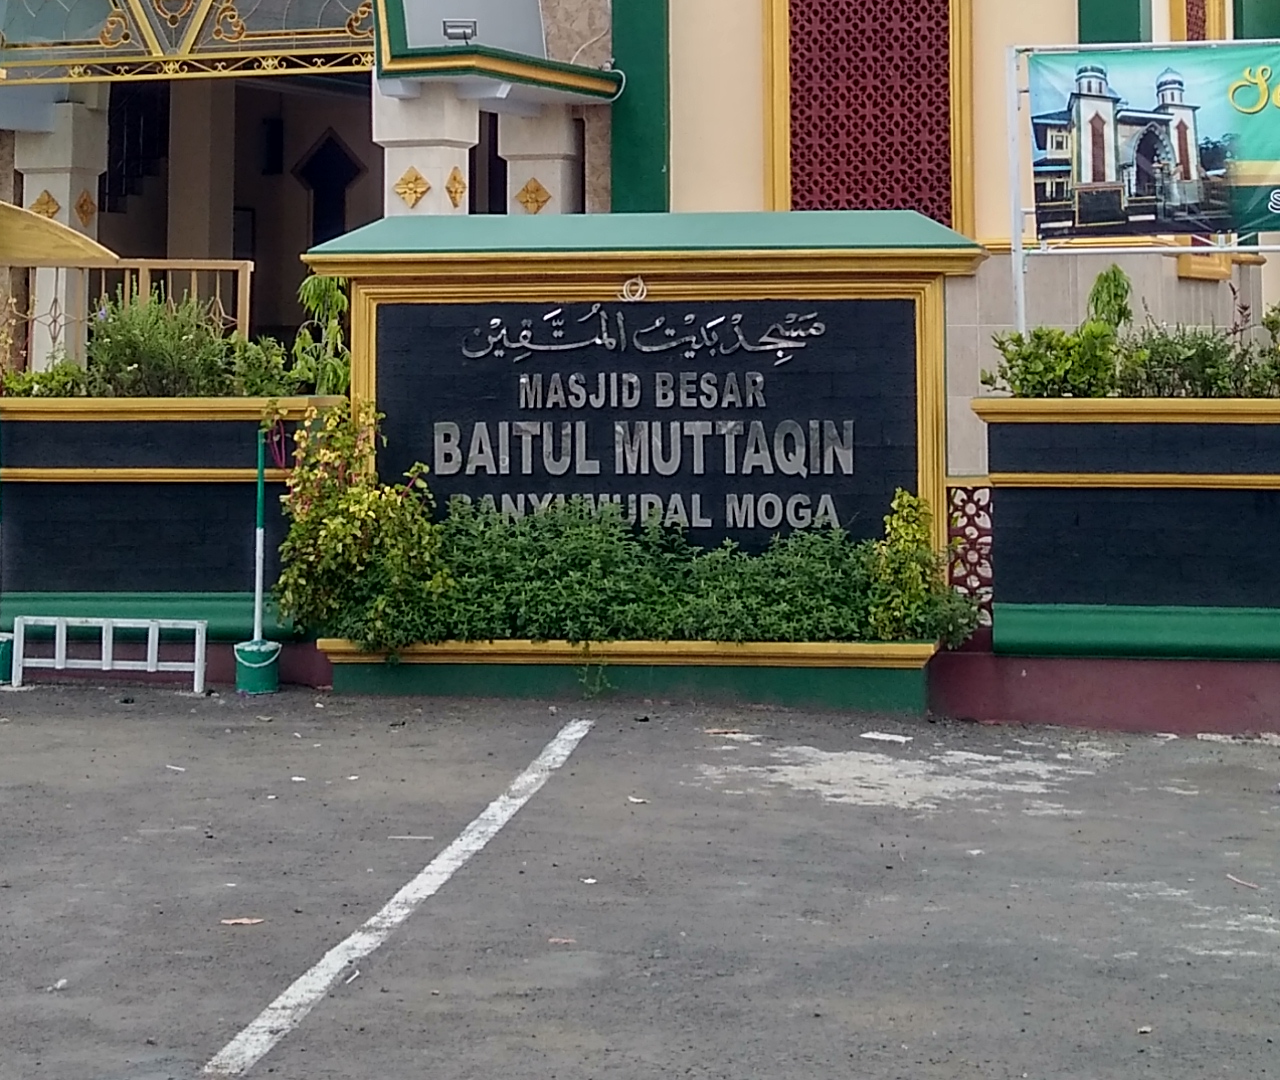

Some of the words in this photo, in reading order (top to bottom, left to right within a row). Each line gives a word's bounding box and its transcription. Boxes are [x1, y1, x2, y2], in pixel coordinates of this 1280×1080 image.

[520, 373, 641, 408] MASJID
[655, 372, 766, 408] BESAR
[433, 420, 600, 476] BAITUL
[614, 419, 856, 478] MUTTAQIN
[725, 493, 841, 529] MOGA
